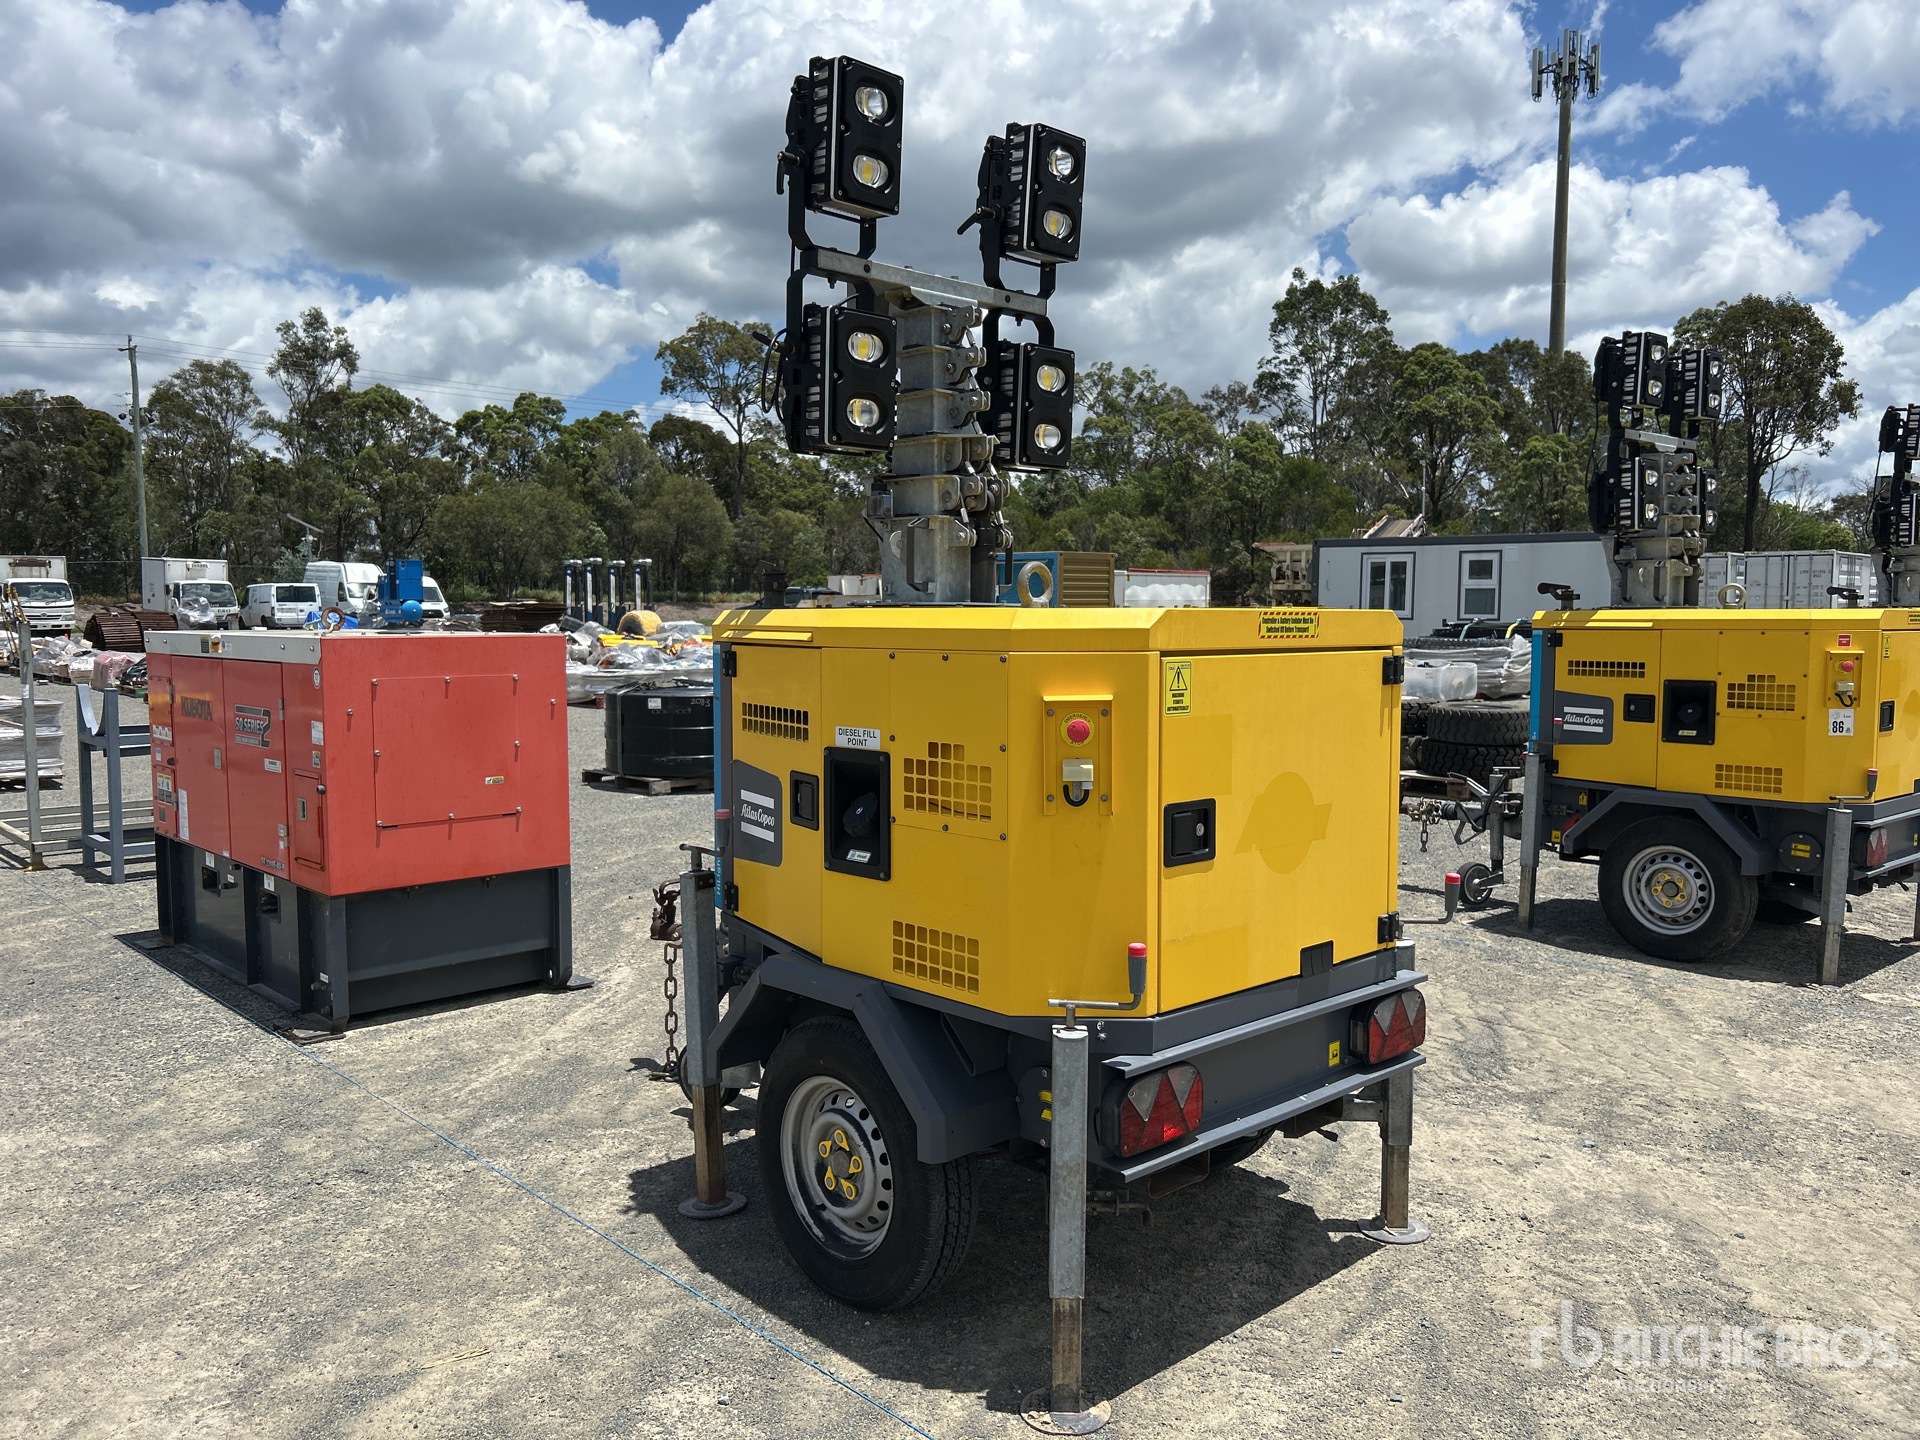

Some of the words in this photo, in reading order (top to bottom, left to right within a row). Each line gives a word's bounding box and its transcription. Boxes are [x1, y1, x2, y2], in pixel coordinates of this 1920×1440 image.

[1280, 616, 1291, 625] Battery
[181, 696, 213, 721] KUBOTA
[1064, 713, 1091, 724] EMERGENCY
[1563, 713, 1583, 724] Atlas
[1583, 715, 1604, 725] Copco
[244, 718, 264, 735] SERIES
[1832, 720, 1845, 734] 86
[838, 727, 862, 738] DIESEL
[862, 730, 877, 739] FILL
[847, 737, 868, 747] POINT
[740, 803, 758, 821] Atlas
[757, 808, 775, 827] Copco
